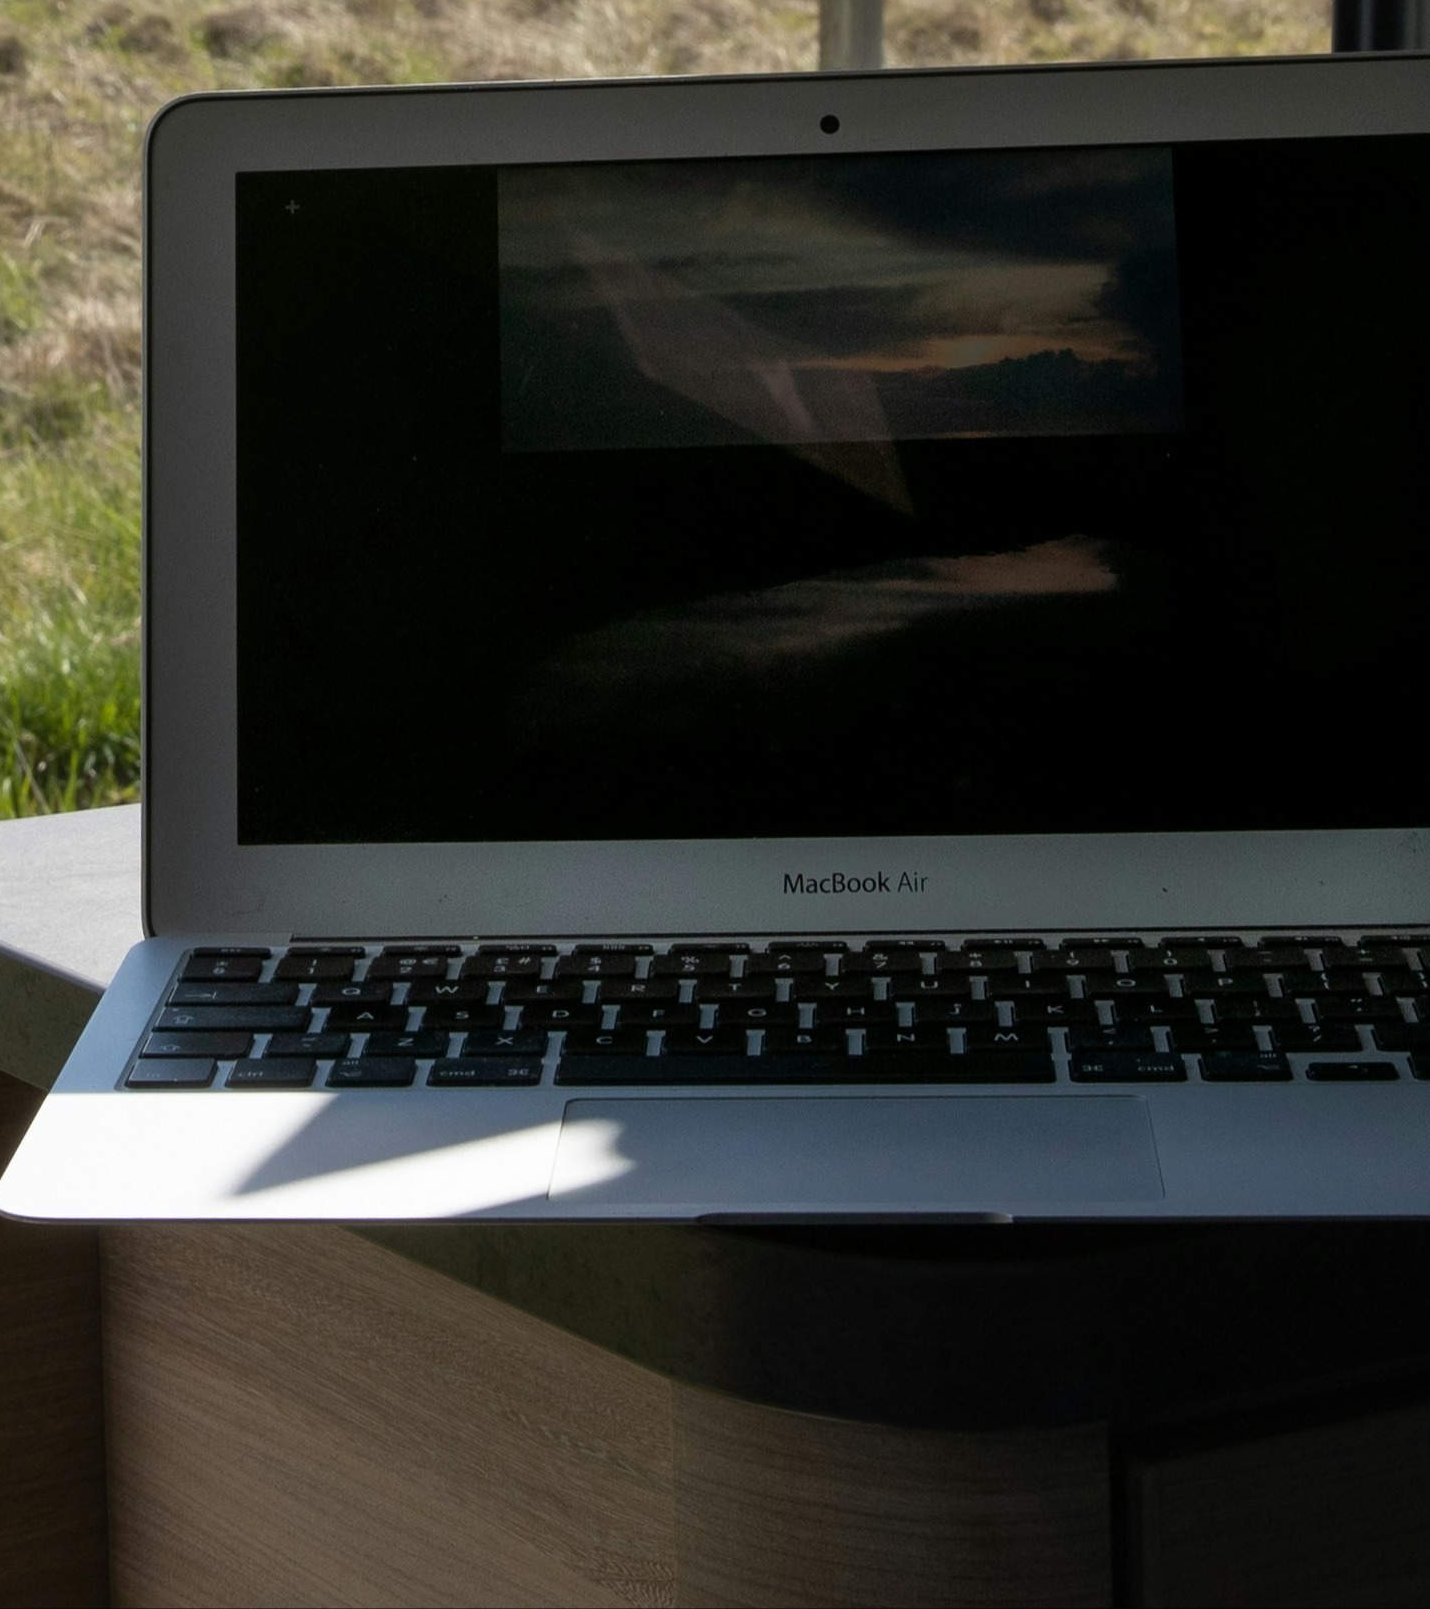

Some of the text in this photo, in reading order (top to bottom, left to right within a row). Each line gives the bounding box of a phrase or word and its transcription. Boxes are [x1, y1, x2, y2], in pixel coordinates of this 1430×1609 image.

[782, 870, 929, 895] MacBook Air
[342, 987, 361, 996] Q
[435, 985, 459, 994] W
[536, 985, 550, 994] E
[630, 984, 646, 993] R
[728, 983, 742, 992] T
[825, 982, 840, 990] Y
[920, 980, 939, 989] U
[1116, 978, 1137, 988] O
[1217, 977, 1234, 987] P
[355, 1003, 1164, 1020] A S D F G H J K L
[397, 1032, 1019, 1047] Z X C V B N M
[238, 1070, 264, 1078] ctrl
[439, 1069, 475, 1077] cmd
[1137, 1064, 1175, 1072] cmd
